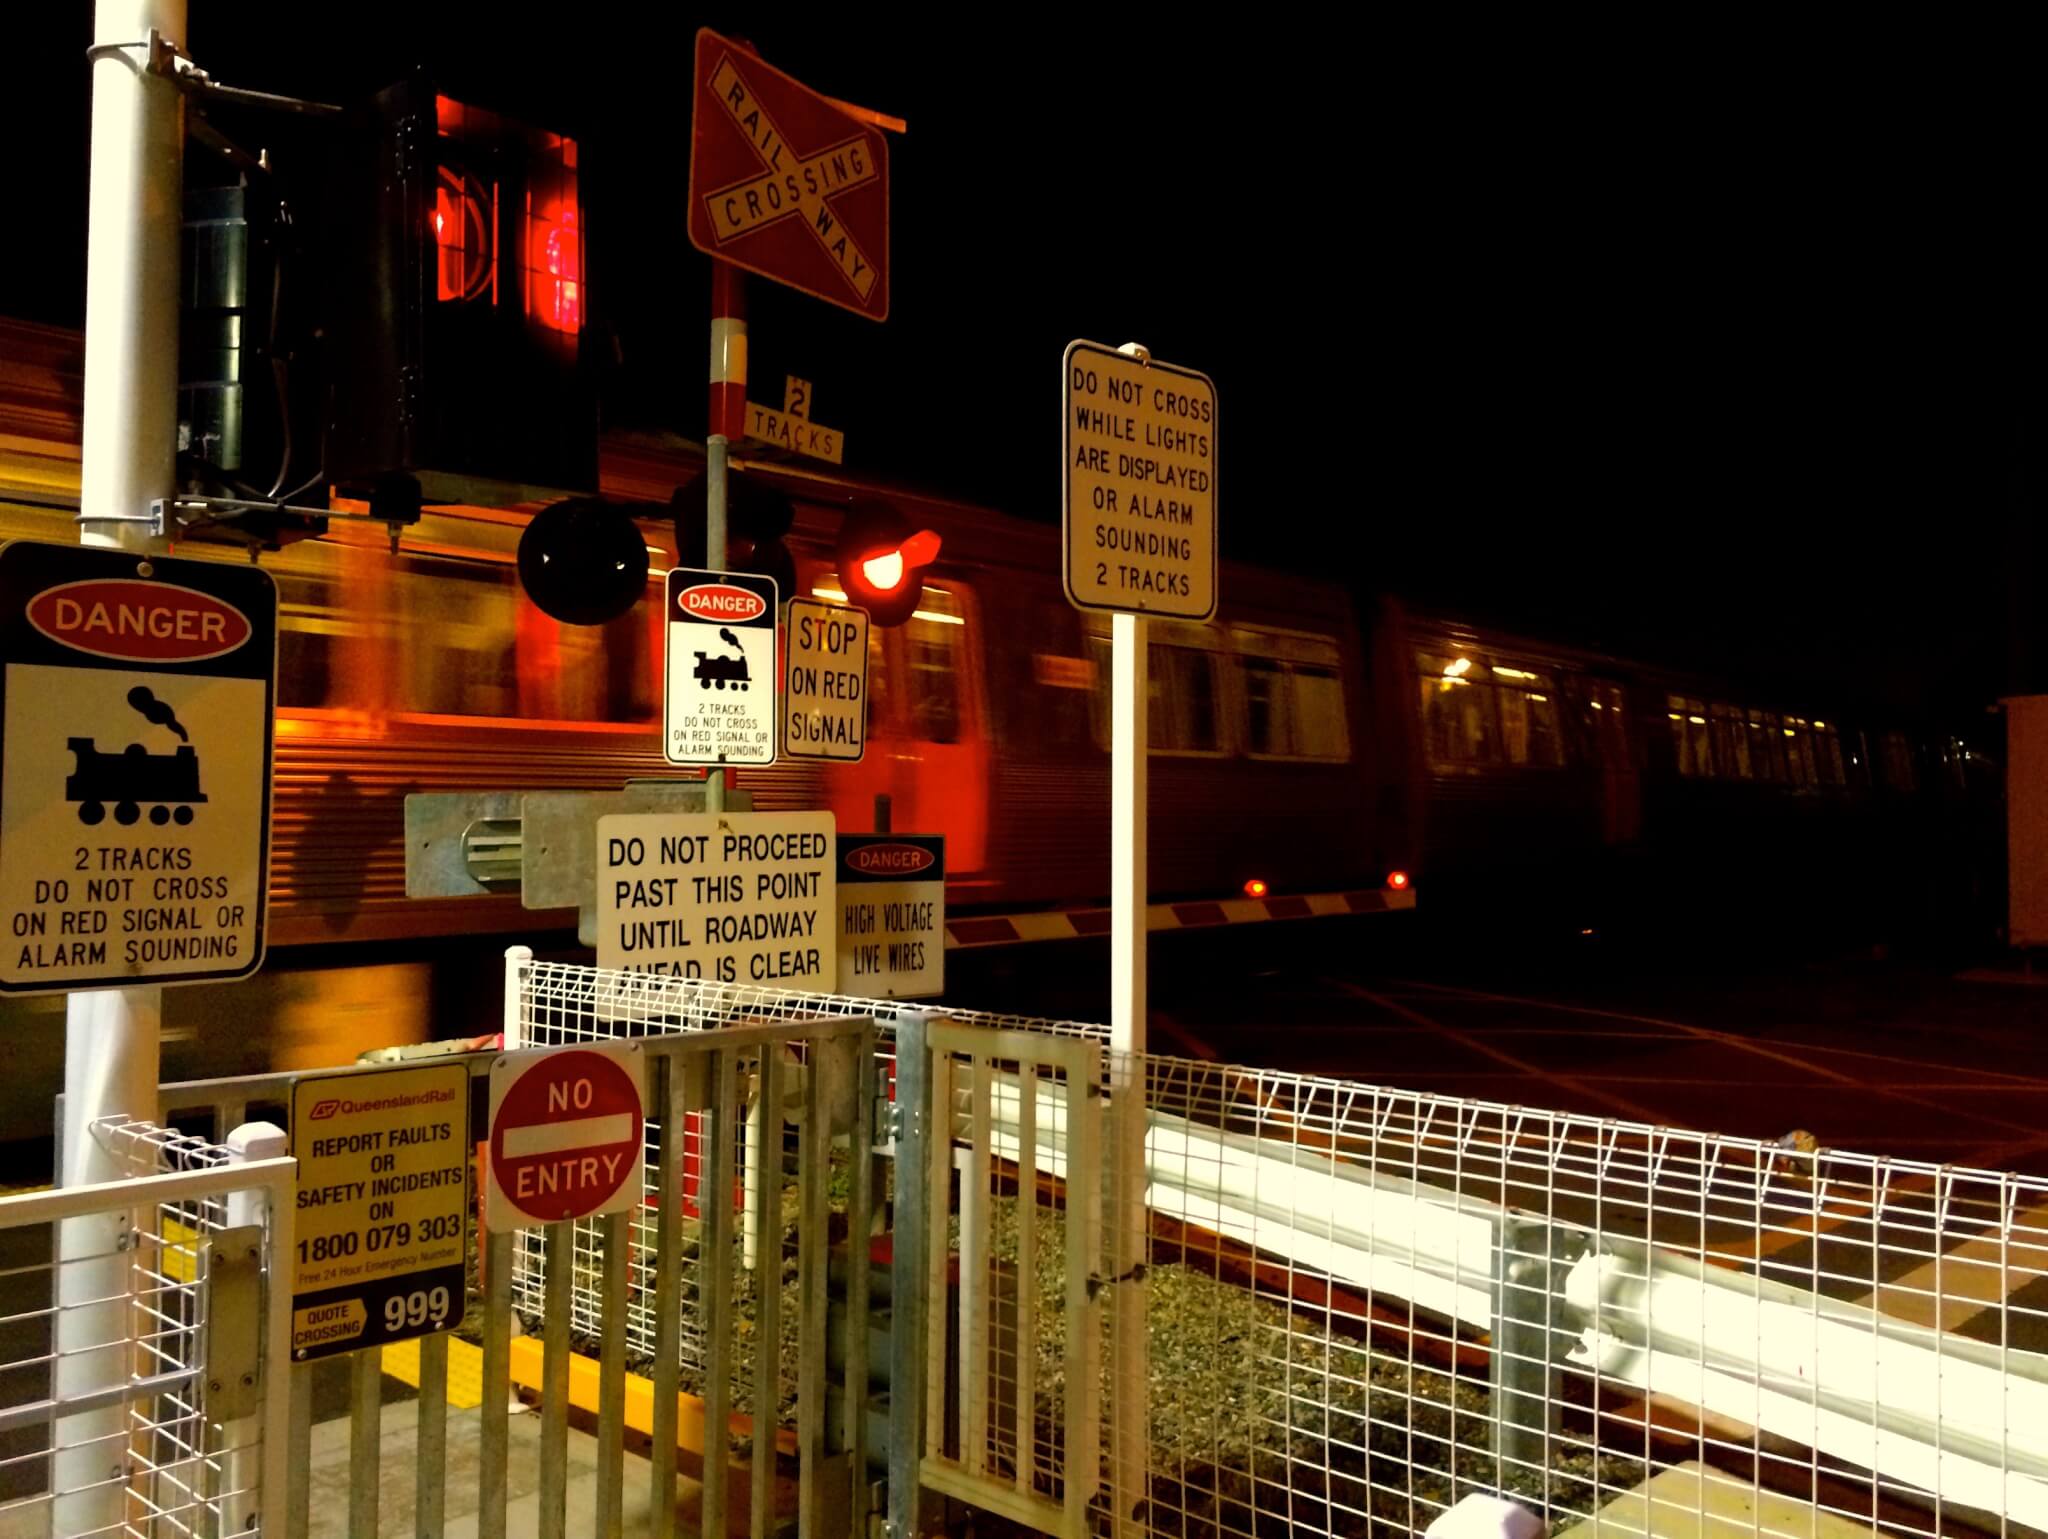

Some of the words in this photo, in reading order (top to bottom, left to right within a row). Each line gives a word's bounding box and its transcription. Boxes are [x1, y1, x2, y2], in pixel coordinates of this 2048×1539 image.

[725, 148, 864, 227] CROSSING
[727, 81, 781, 172] RAIL
[817, 206, 867, 279] WAY
[790, 387, 806, 417] 2
[1073, 367, 1097, 394] DO
[1108, 376, 1143, 406] NOT
[1154, 389, 1210, 423] CROSS
[754, 411, 833, 455] TRACKS
[1076, 406, 1135, 442] WHILE
[1146, 423, 1208, 457] LIGHTS
[1075, 445, 1110, 473] ARE
[1119, 454, 1208, 492] DISPLAYED
[1093, 486, 1117, 513] OR
[1128, 494, 1193, 526] ALARM
[1095, 524, 1190, 561] SOUNDING
[1096, 562, 1107, 585] 2
[1118, 565, 1189, 596] TRACKS
[688, 593, 757, 613] DANGER
[55, 598, 225, 643] DANGER
[800, 616, 857, 655] STOP
[792, 666, 817, 697] ON
[823, 671, 860, 701] RED
[684, 716, 699, 728] DO
[703, 717, 721, 729] NOT
[726, 718, 758, 730] CROSS
[698, 703, 705, 715] 2
[709, 704, 746, 716] TRACKS
[673, 729, 687, 741] ON
[692, 730, 711, 742] RED
[716, 731, 750, 743] SIGNAL
[755, 732, 768, 744] OR
[792, 712, 859, 745] SIGNAL
[677, 744, 712, 756] ALARM
[718, 745, 764, 757] SOUNDING
[75, 847, 90, 870] 2
[98, 847, 192, 871] TRACKS
[609, 838, 645, 867] DO
[660, 836, 709, 865] NOT
[723, 832, 827, 862] PROCEED
[860, 851, 920, 868] DANGER
[35, 879, 69, 904] DO
[87, 878, 134, 902] NOT
[153, 876, 228, 901] CROSS
[616, 878, 678, 909] PAST
[692, 875, 743, 904] THIS
[758, 871, 821, 900] POINT
[12, 912, 46, 937] ON
[60, 910, 107, 935] RED
[122, 907, 202, 932] SIGNAL
[216, 905, 245, 929] OR
[620, 919, 690, 951] UNTIL
[706, 910, 817, 944] ROADWAY
[845, 905, 875, 935] HIGH
[883, 902, 933, 932] VOLTAGE
[17, 941, 106, 969] ALARM
[124, 935, 238, 964] SOUNDING
[717, 956, 736, 983] IS
[750, 949, 820, 980] CLEAR
[854, 945, 880, 975] LIVE
[889, 942, 924, 972] WIRES
[341, 1088, 455, 1114] QueenslandRail
[548, 1078, 592, 1113] NO
[312, 1133, 383, 1158] REPORT
[389, 1123, 451, 1146] FAULTS
[370, 1154, 395, 1174] OR
[516, 1153, 623, 1199] ENTRY
[296, 1182, 365, 1209] SAFETY
[372, 1167, 462, 1197] INCIDENTS
[369, 1201, 394, 1221] ON
[297, 1230, 358, 1264] 1800
[366, 1222, 411, 1252] 079
[418, 1214, 461, 1242] 303
[299, 1271, 320, 1285] Free
[323, 1268, 337, 1281] 24
[340, 1263, 362, 1277] Hour
[365, 1255, 417, 1275] Emergency
[420, 1247, 457, 1263] Number
[307, 1305, 349, 1325] QUOTE
[384, 1286, 450, 1332] 999
[295, 1321, 360, 1346] CROSSING
